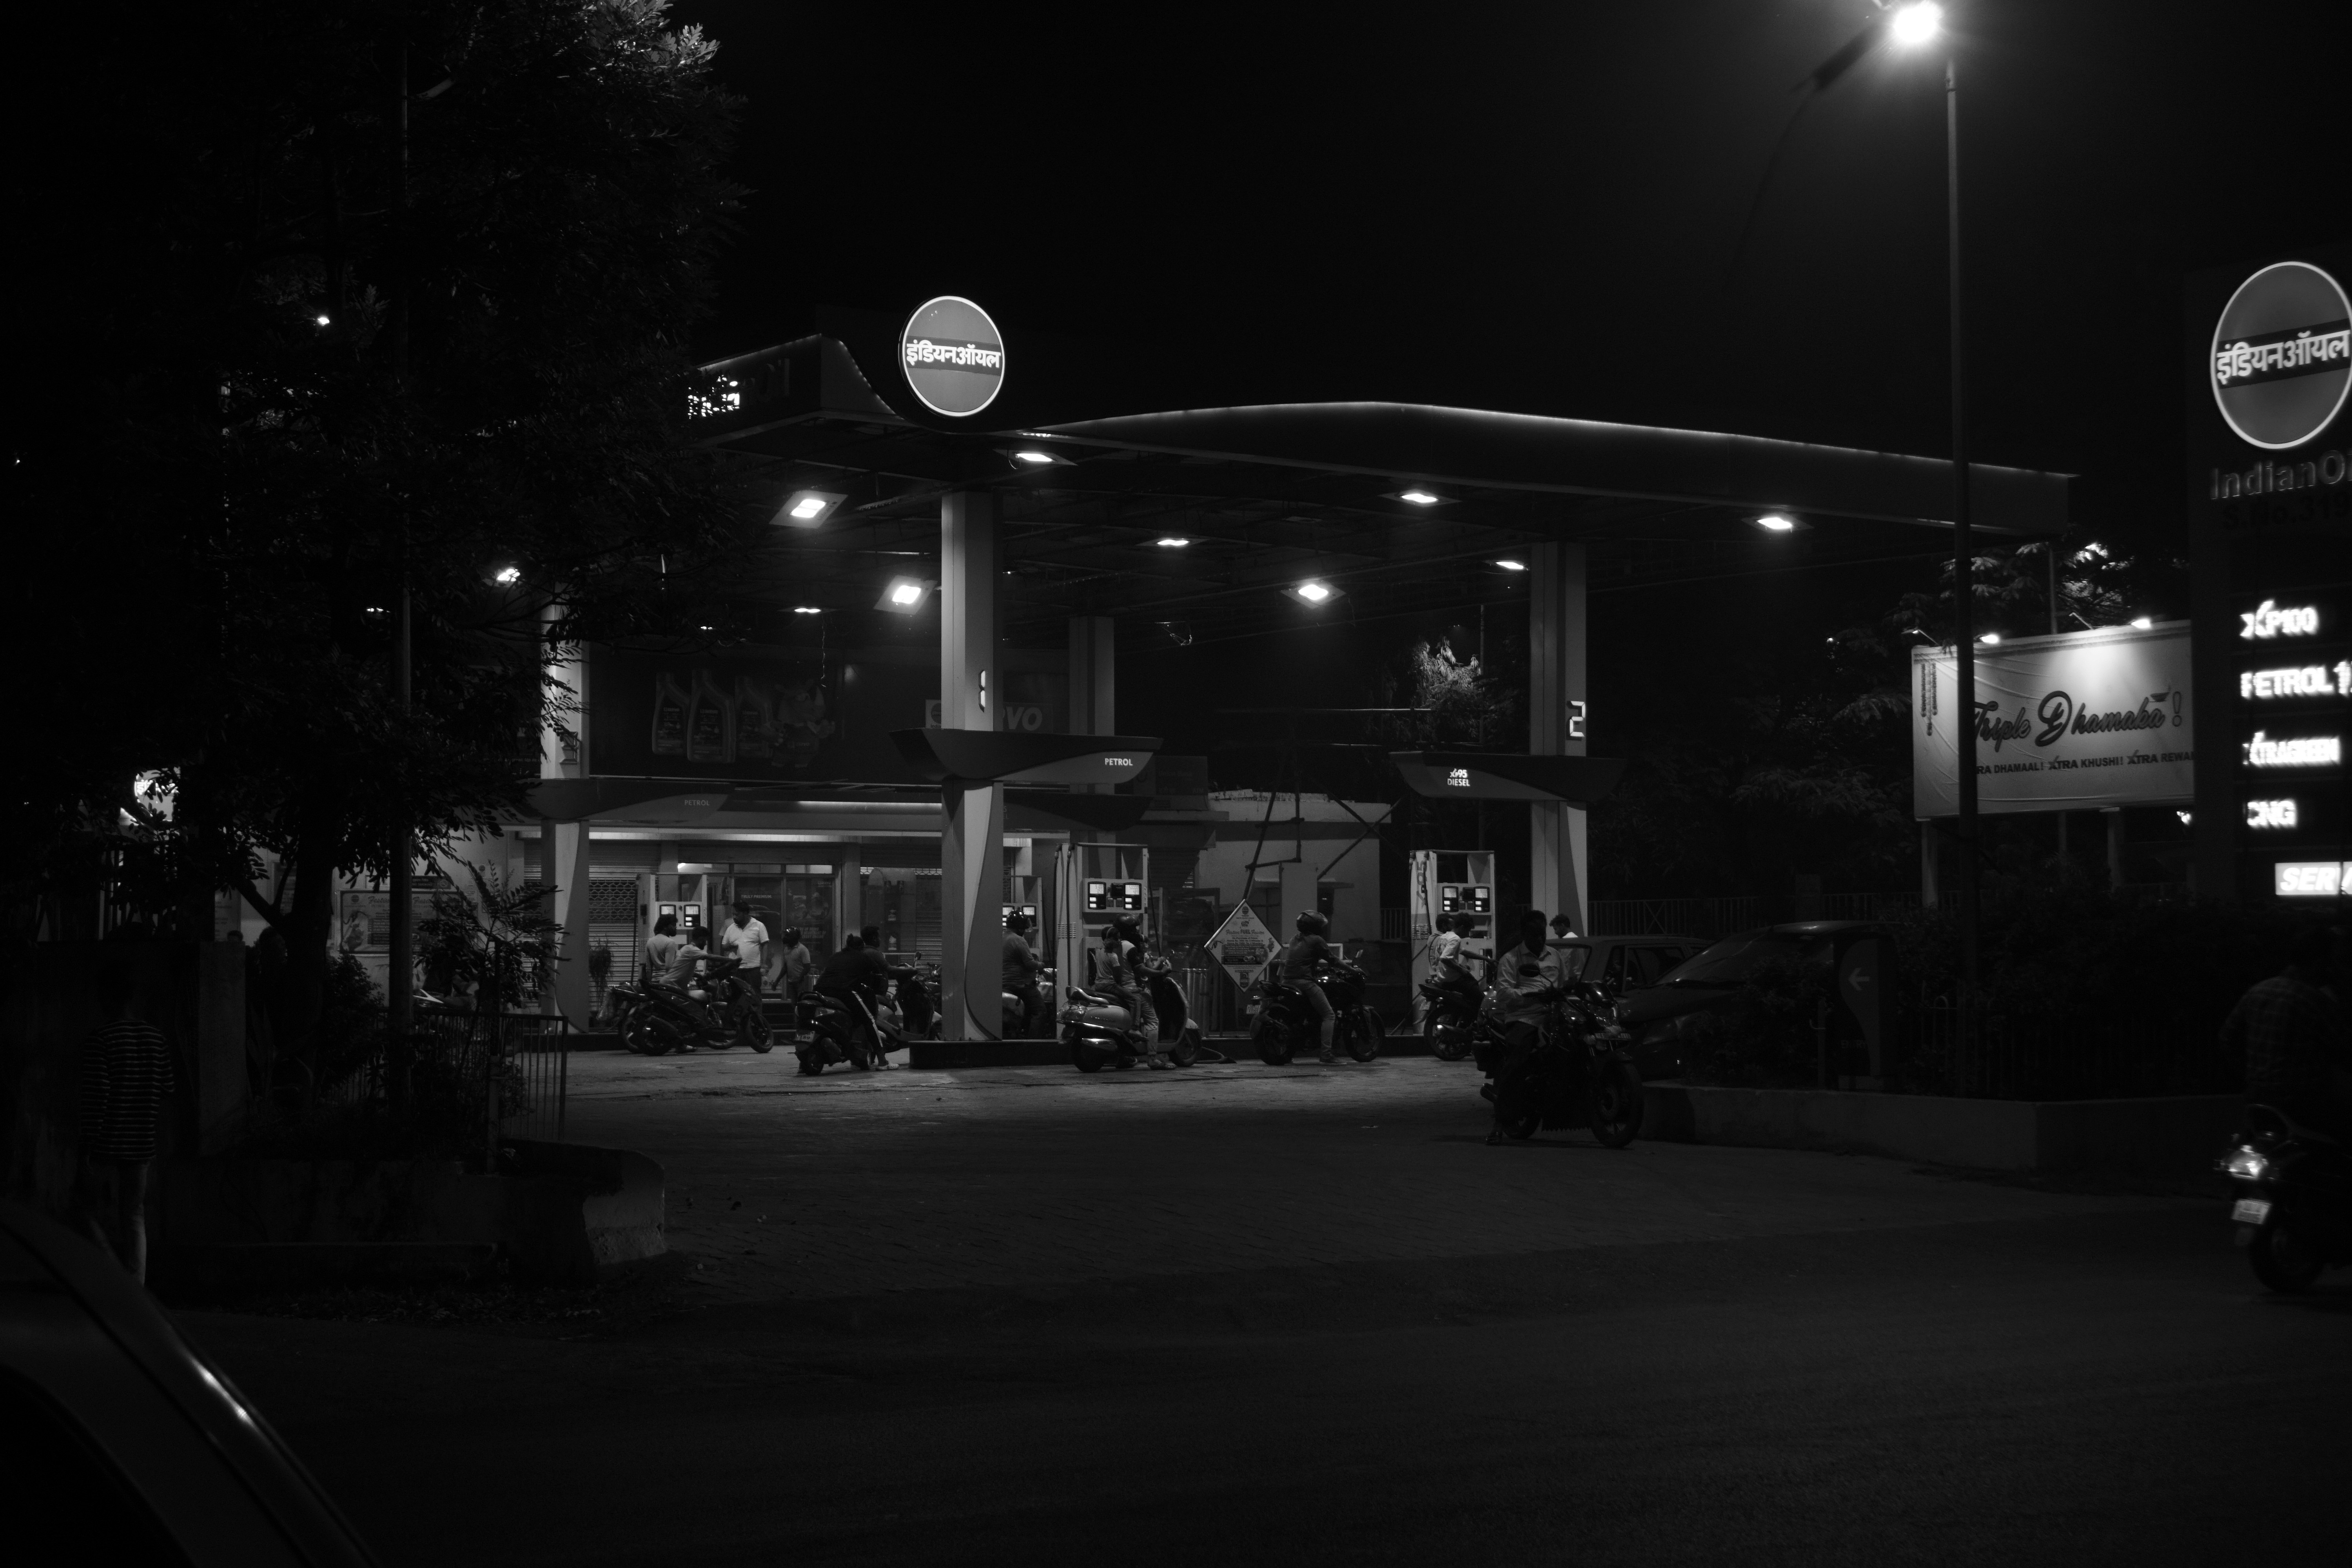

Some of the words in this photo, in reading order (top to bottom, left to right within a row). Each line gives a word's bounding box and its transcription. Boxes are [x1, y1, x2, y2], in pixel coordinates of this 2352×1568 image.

[906, 339, 1001, 368] इंडियनऑयल
[2216, 330, 2351, 385] इंडियनऑयल
[2333, 659, 2352, 697] 1
[1002, 706, 1043, 732] VO
[1569, 700, 1586, 739] 2
[1105, 757, 1133, 766] PETROL
[1994, 761, 2044, 773] DHAMAAL!
[2048, 755, 2078, 771] XTRA
[2080, 756, 2123, 768] KHUSHI!
[2127, 750, 2158, 765] XTRA
[1447, 778, 1470, 787] DIESEL
